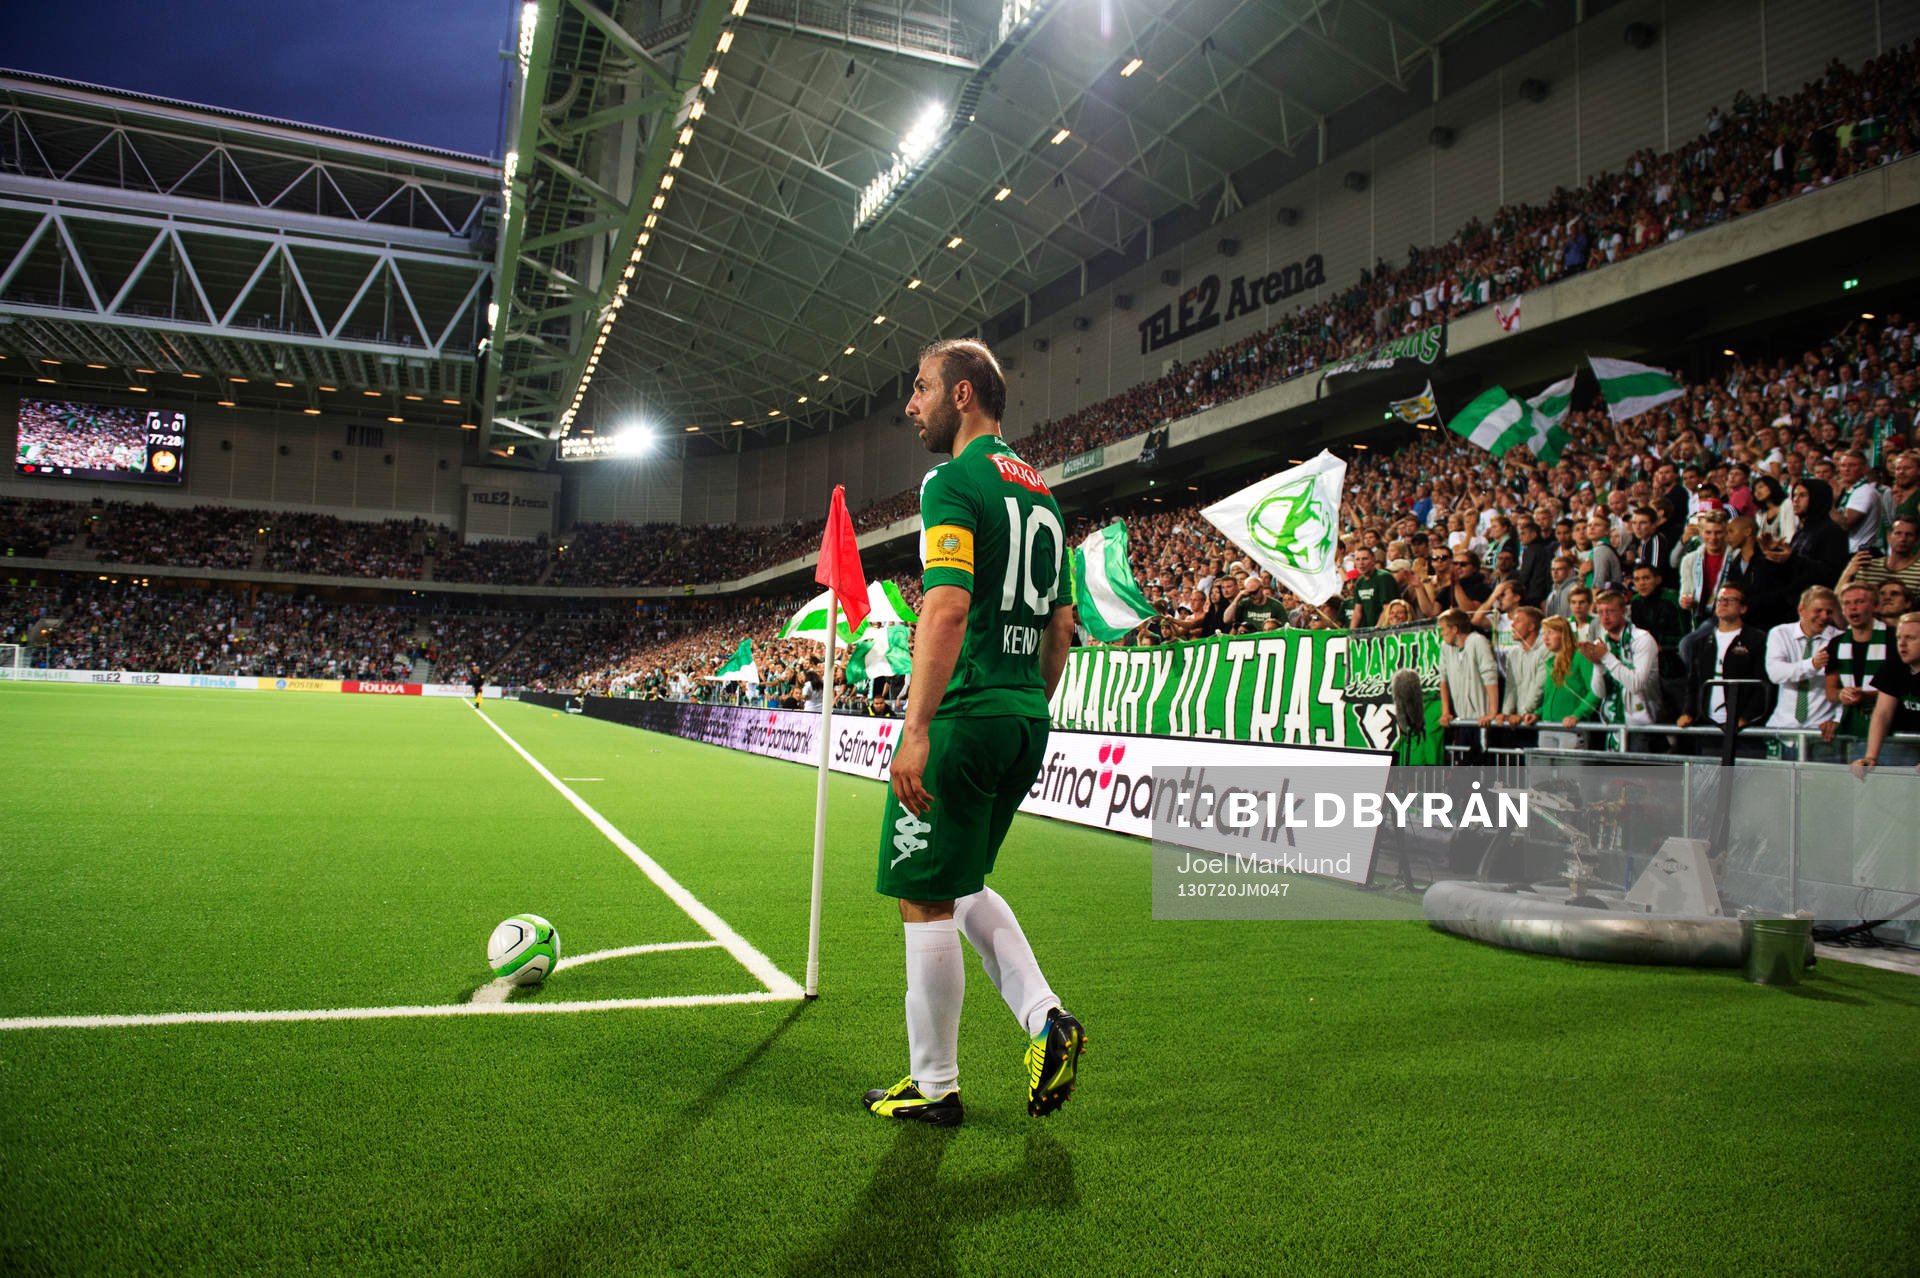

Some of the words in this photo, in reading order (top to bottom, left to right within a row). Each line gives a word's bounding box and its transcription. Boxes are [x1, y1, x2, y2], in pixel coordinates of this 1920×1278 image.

[1138, 274, 1221, 355] TELE2
[1224, 253, 1327, 322] Arena
[149, 433, 182, 447] 77:28
[151, 418, 161, 430] 0
[171, 420, 181, 432] 0
[992, 455, 1048, 491] FOLKIA
[472, 491, 510, 506] TELE2
[512, 496, 550, 509] Arena
[1000, 497, 1064, 616] 10
[92, 673, 121, 683] TELE2
[131, 674, 160, 684] TELE2
[1168, 636, 1348, 748] ULTRAS
[836, 729, 878, 767] Sefina
[1105, 766, 1304, 848] pantbank
